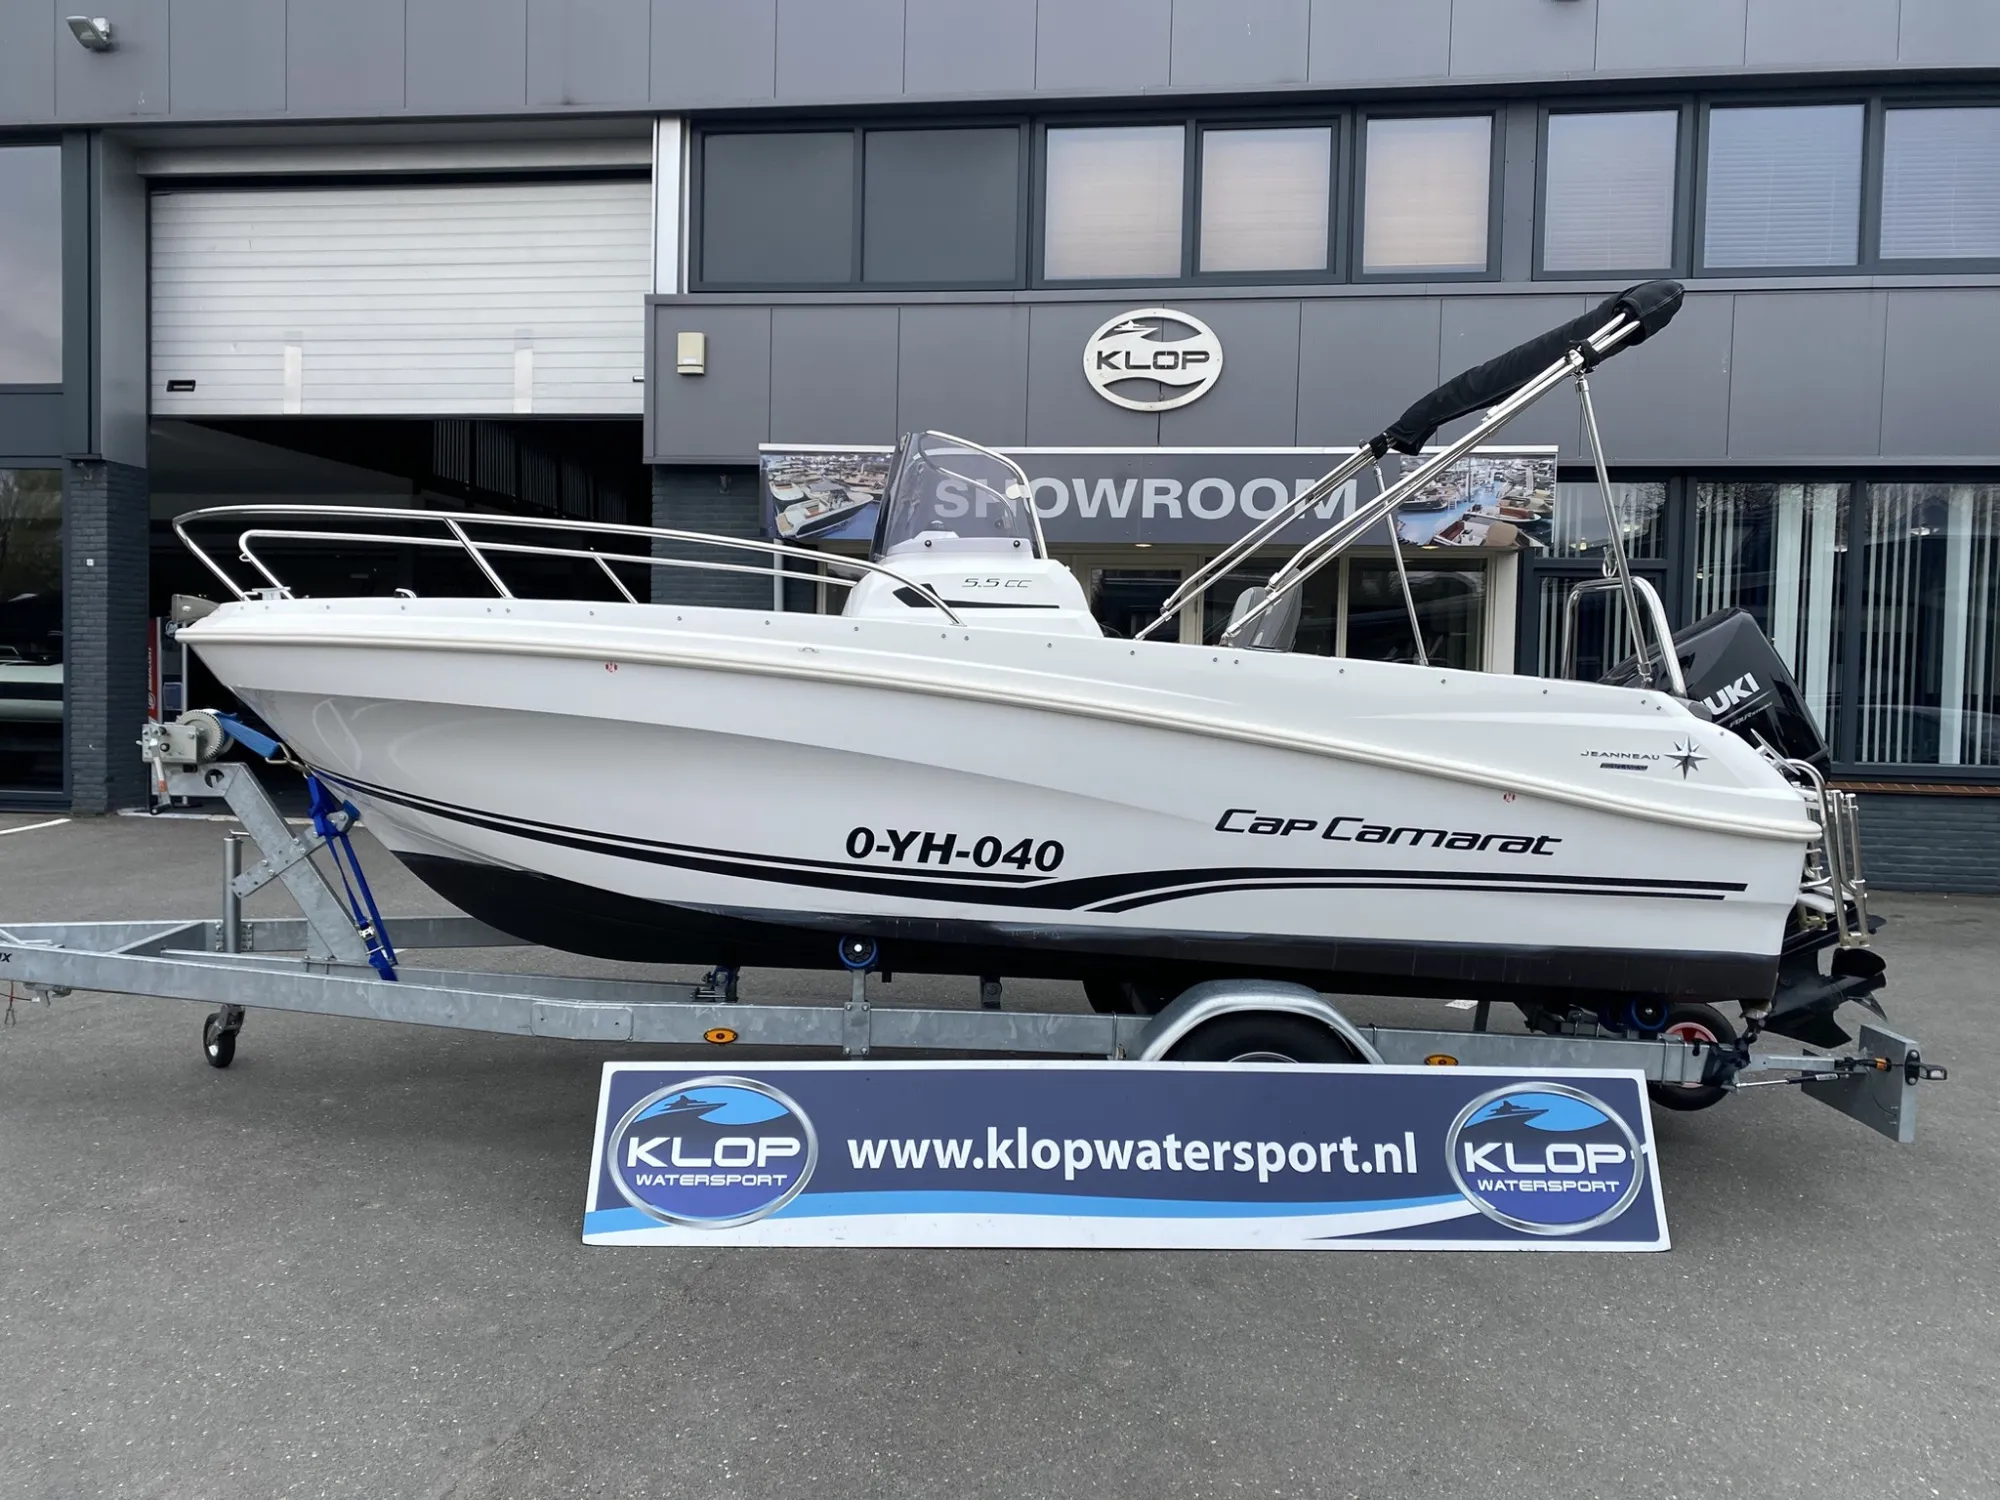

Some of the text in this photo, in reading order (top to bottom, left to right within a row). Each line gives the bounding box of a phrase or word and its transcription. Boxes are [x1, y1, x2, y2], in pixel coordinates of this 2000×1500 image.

[1096, 350, 1210, 371] KLOP
[934, 477, 1358, 520] SHOWROOM
[961, 578, 1032, 588] 5.5 CC
[1702, 672, 1760, 716] UKI
[1580, 751, 1660, 760] JEANNEAU
[845, 826, 1065, 873] 0-YH-040
[1321, 816, 1563, 856] Camarat
[626, 1136, 801, 1168] KLOP
[847, 1126, 1418, 1180] www.klopwatersport.nl
[1464, 1142, 1625, 1174] KLOP
[635, 1174, 788, 1187] WATERSPORT
[1477, 1179, 1620, 1193] WATERSPORT
